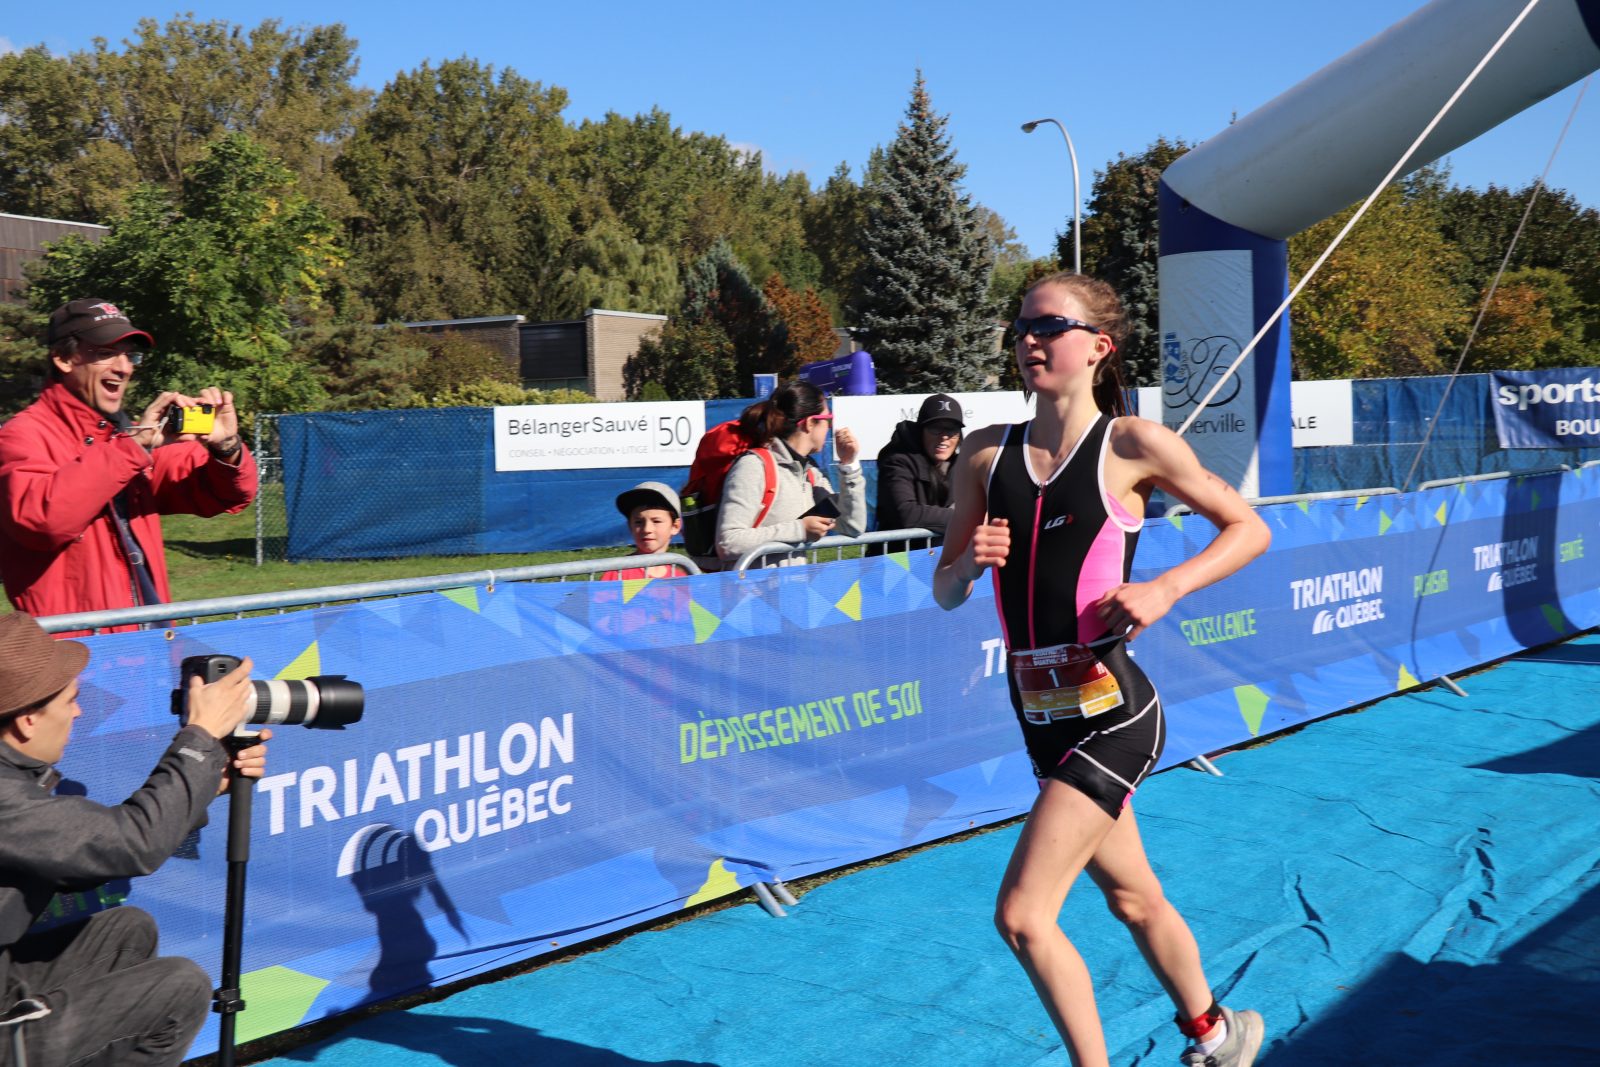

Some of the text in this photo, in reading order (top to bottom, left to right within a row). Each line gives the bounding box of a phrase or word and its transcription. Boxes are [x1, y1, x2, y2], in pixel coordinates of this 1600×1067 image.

[658, 416, 692, 446] 50
[508, 447, 546, 458] CONSEIL
[622, 445, 648, 455] LITIGE
[1473, 536, 1539, 571] TRIATHLON
[1290, 566, 1384, 610] TRIATHLON
[1180, 608, 1257, 646] EXCELLENCE
[1335, 597, 1385, 629] QUÉBEC
[1048, 668, 1060, 688] 1
[853, 688, 886, 727] DE
[887, 681, 922, 720] SOI
[257, 712, 575, 836] TRIATHLON
[414, 774, 573, 852] QUÉBEC
